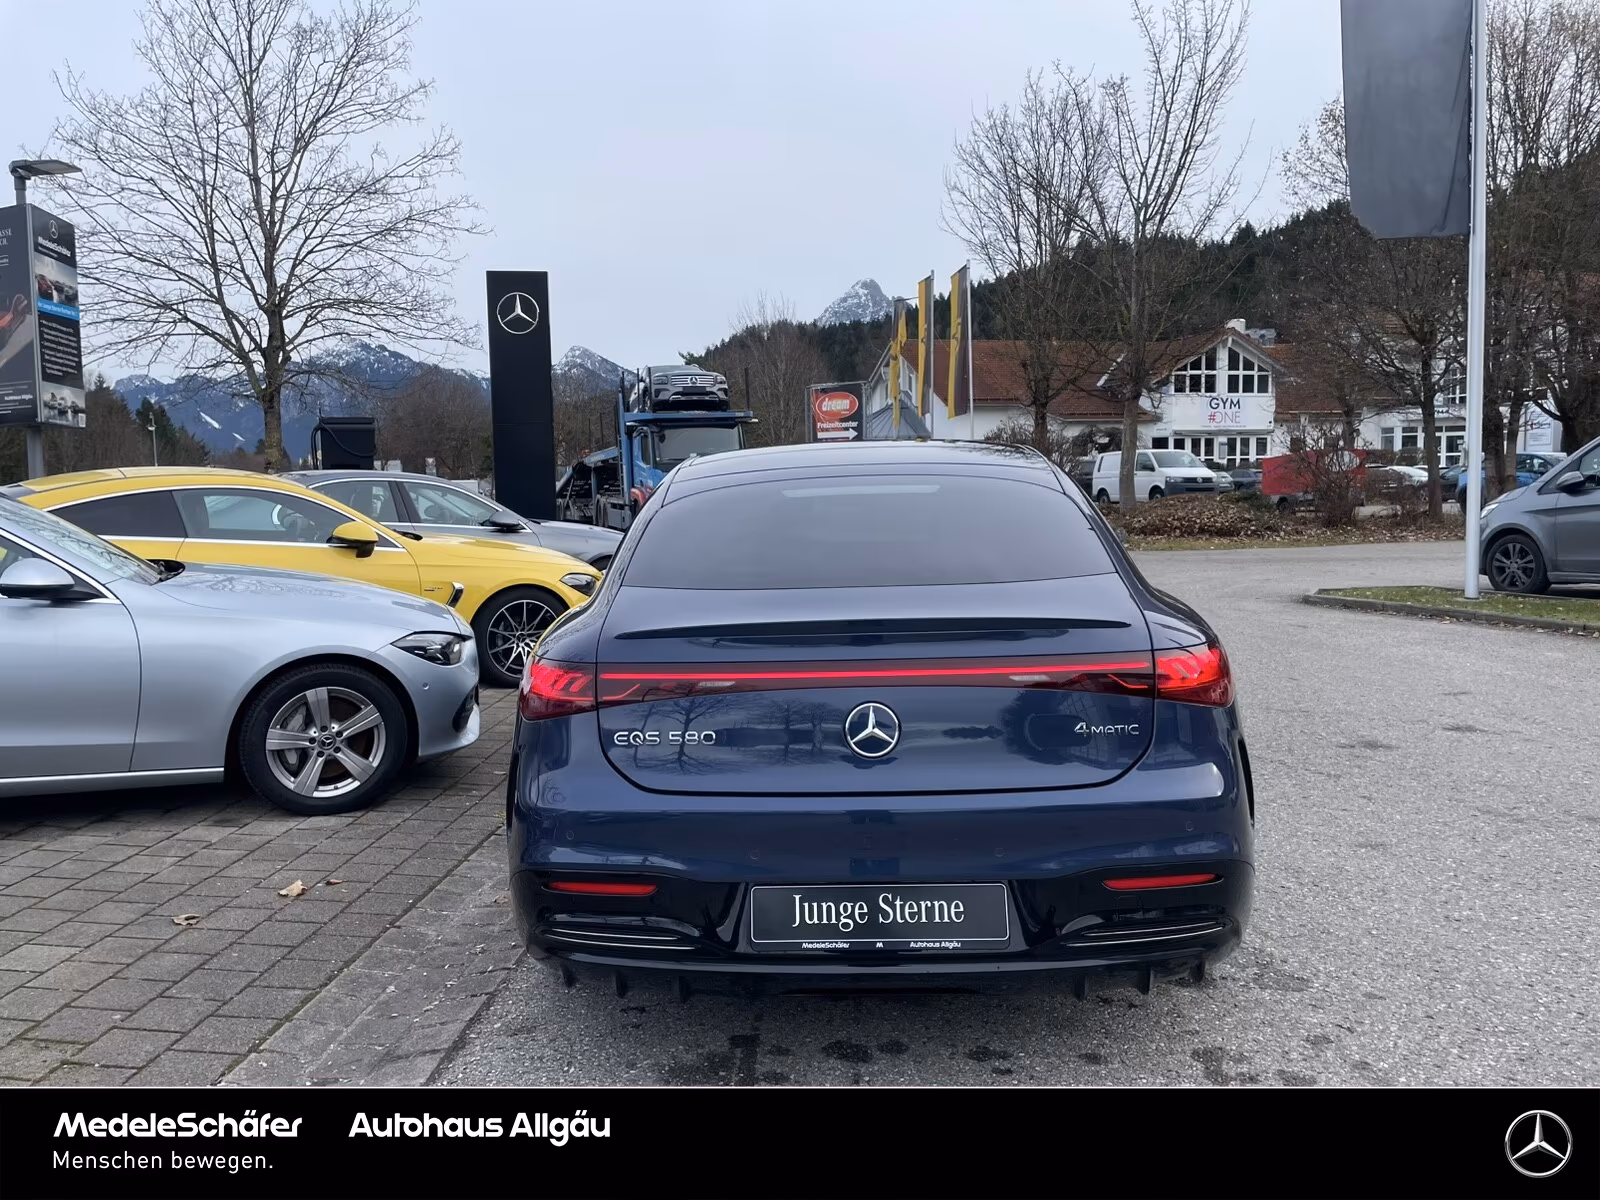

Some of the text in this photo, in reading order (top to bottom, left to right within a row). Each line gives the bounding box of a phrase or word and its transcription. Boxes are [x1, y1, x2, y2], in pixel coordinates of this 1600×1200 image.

[822, 397, 850, 411] dream
[1209, 397, 1241, 410] GYM
[1208, 411, 1241, 424] #ONE
[817, 421, 859, 429] Freizeitcenter
[1073, 722, 1139, 737] 4MATIC
[613, 731, 716, 746] EQS 580
[792, 893, 965, 932] Junge Sterne
[801, 941, 850, 949] MedeleSchäfer
[941, 940, 961, 950] Allgäu
